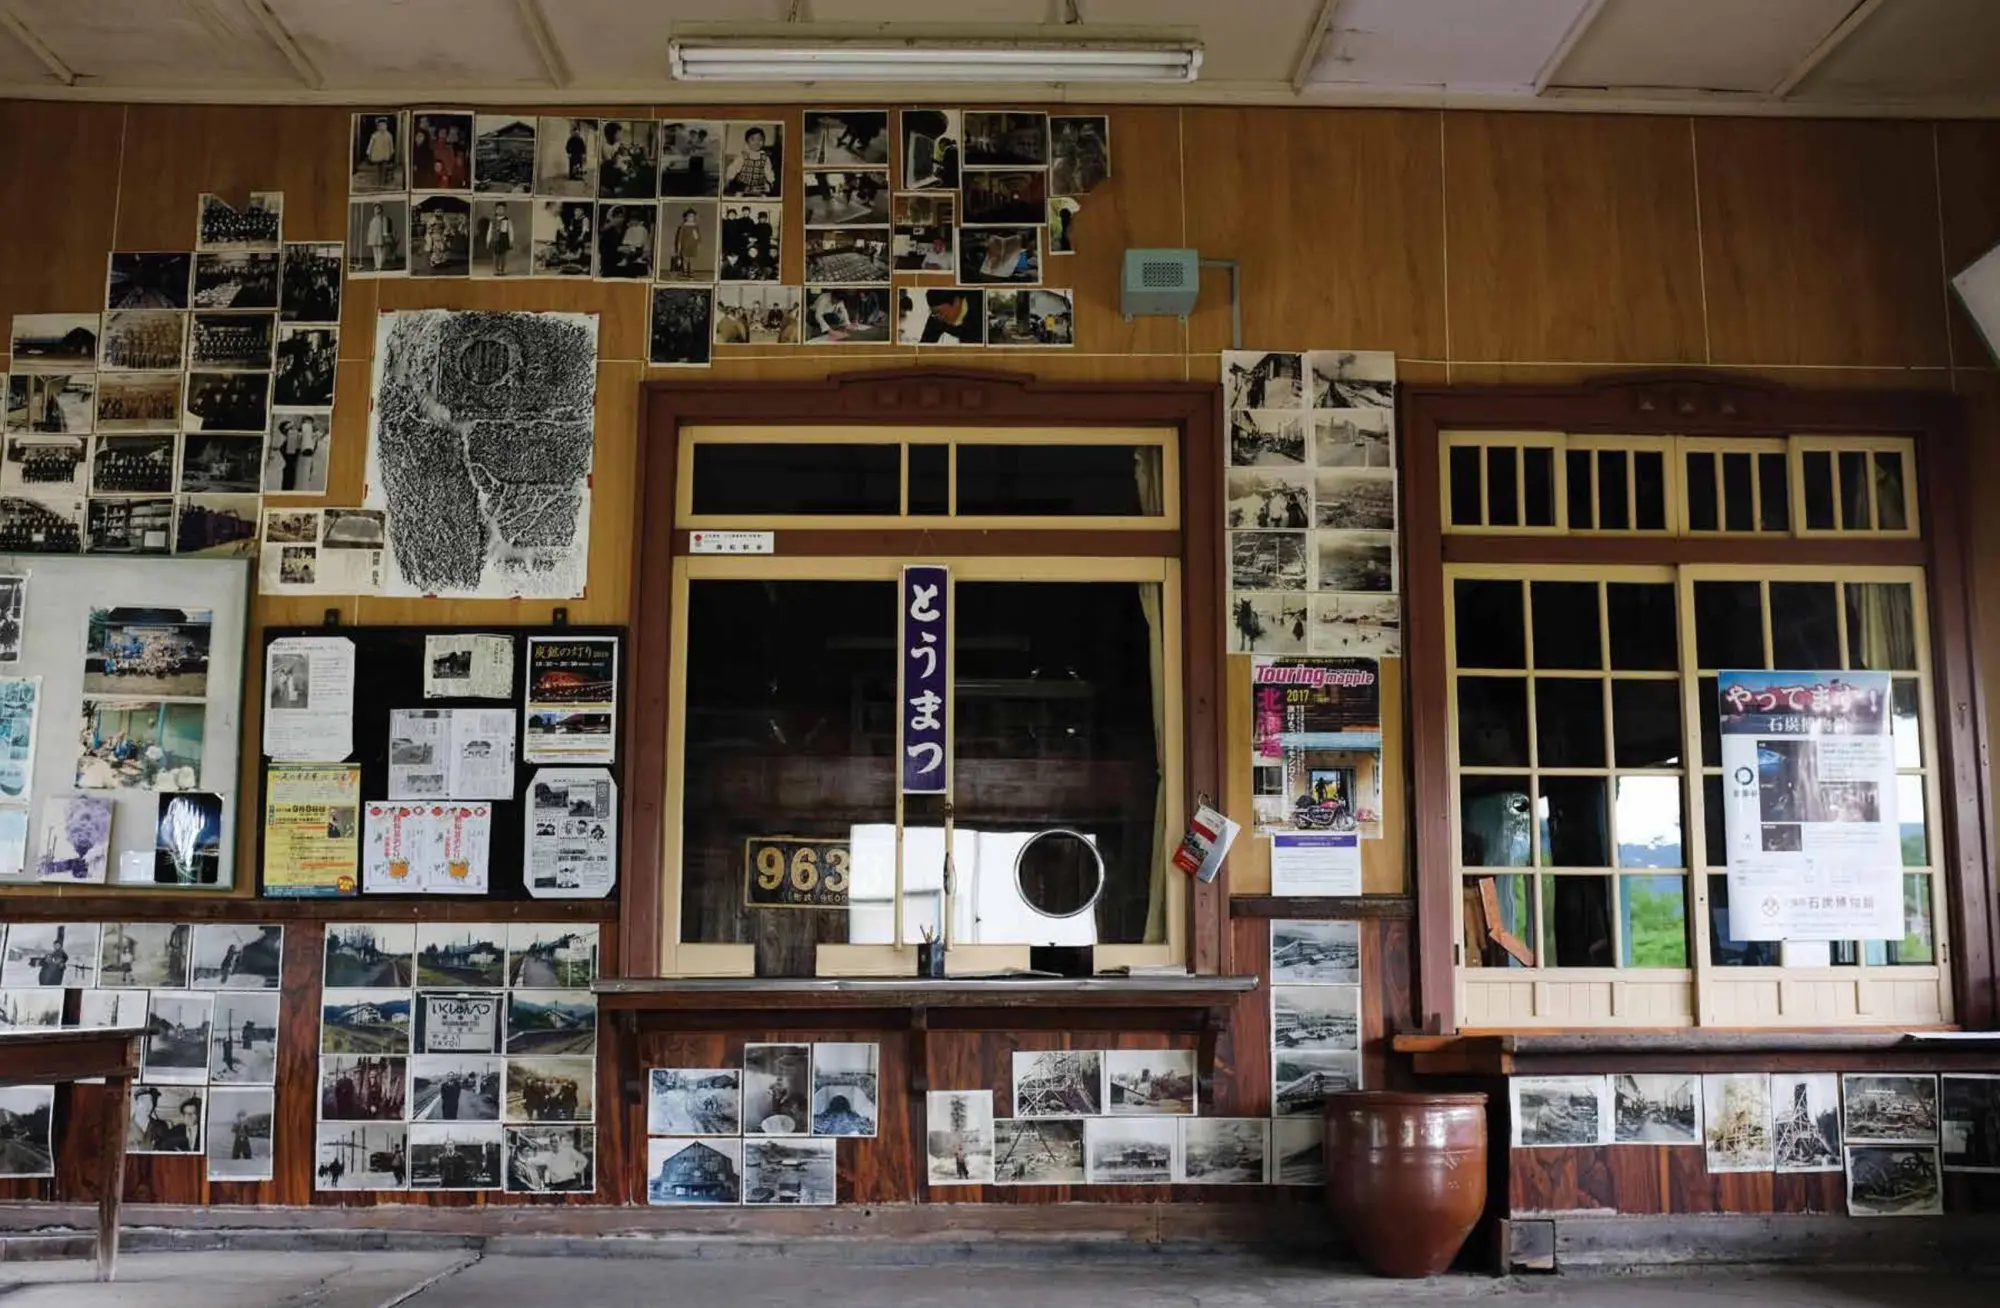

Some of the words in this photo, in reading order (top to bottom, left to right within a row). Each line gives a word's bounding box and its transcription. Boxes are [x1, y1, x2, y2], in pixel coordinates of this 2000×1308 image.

[906, 584, 944, 775] とうまつ
[1254, 664, 1327, 688] Touring
[1326, 671, 1375, 688] mapple
[1286, 689, 1310, 703] 2017
